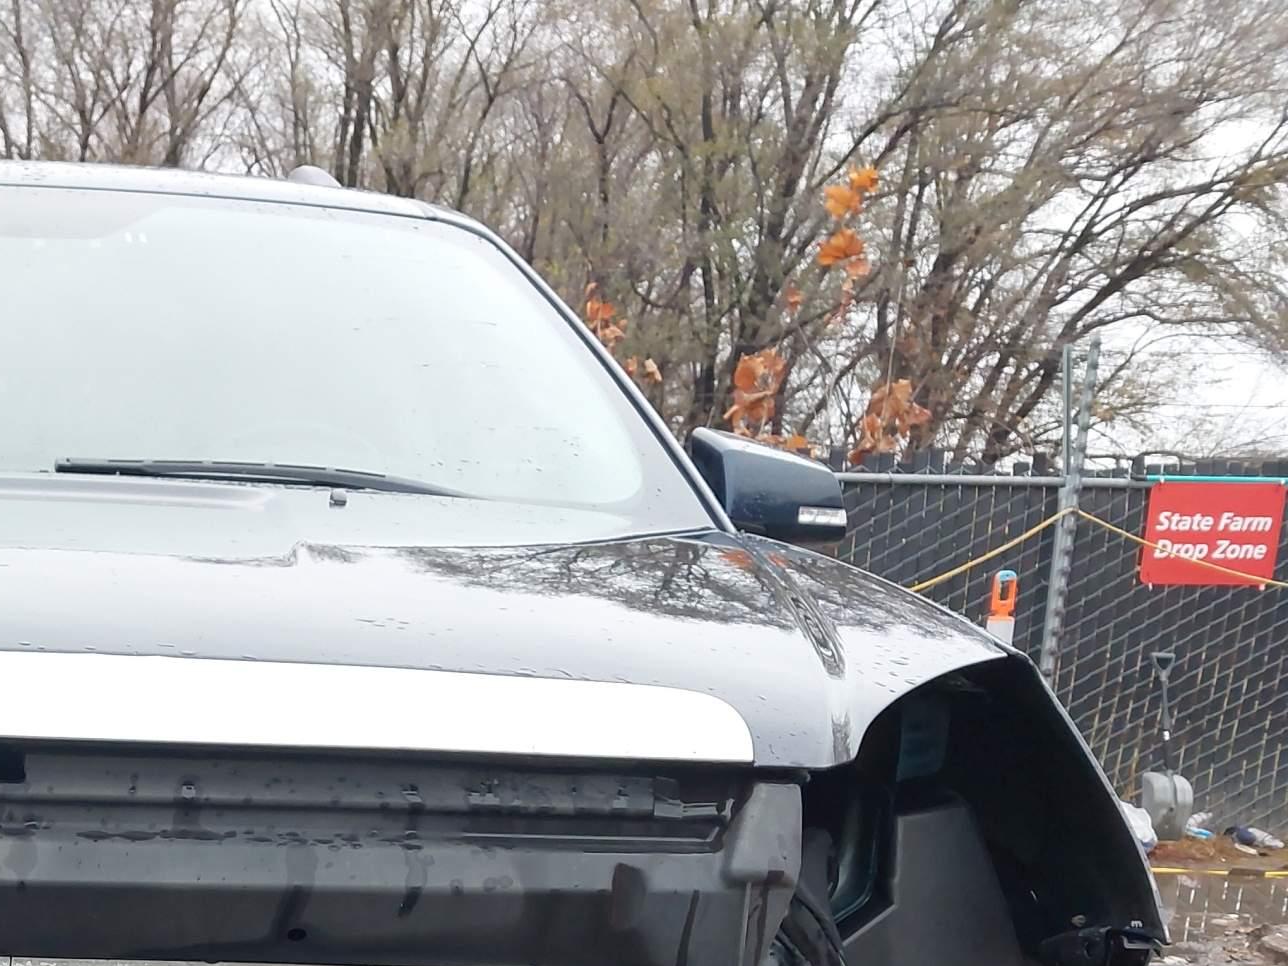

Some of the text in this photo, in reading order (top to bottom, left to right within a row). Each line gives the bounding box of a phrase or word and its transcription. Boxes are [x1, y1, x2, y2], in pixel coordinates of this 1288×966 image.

[1155, 511, 1273, 532] State Farm
[1153, 539, 1268, 561] Drop Zone
